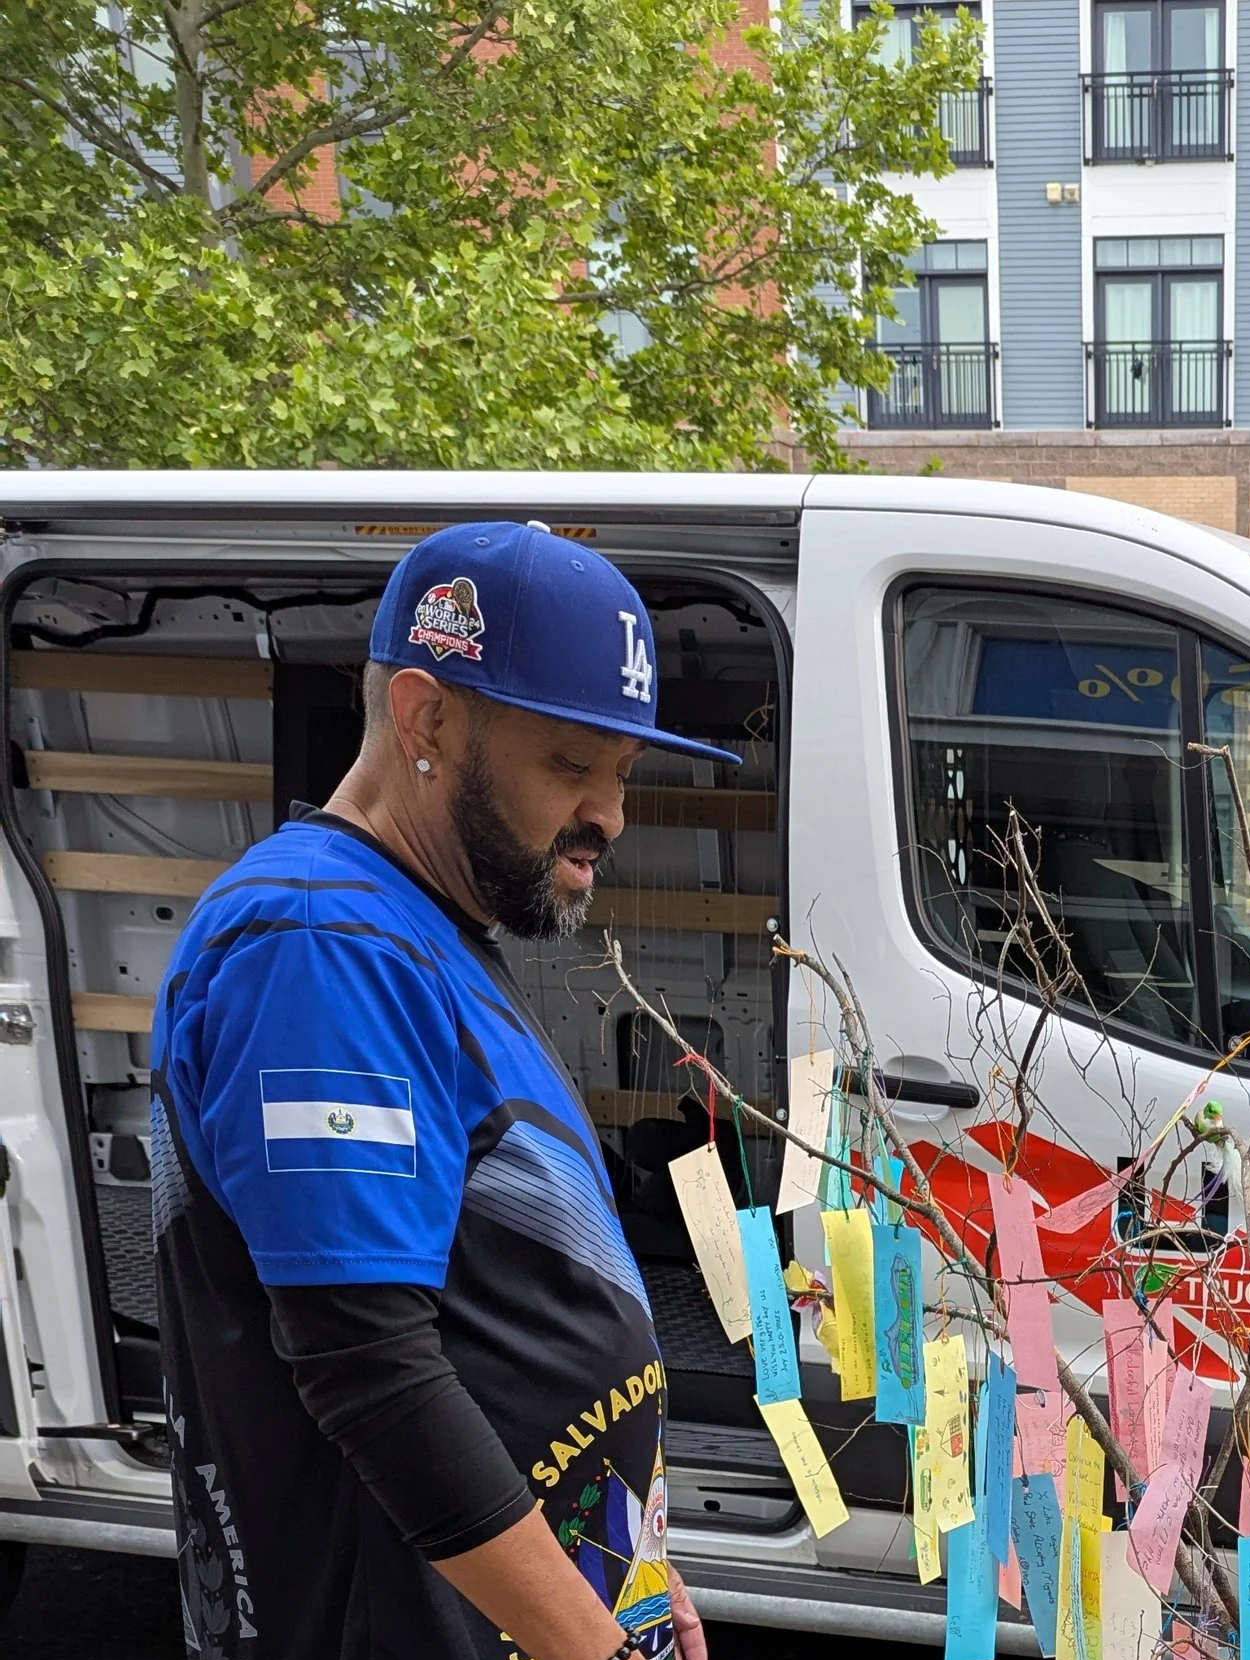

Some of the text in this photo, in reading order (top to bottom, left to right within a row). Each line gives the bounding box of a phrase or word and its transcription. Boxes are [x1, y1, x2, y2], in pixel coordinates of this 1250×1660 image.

[426, 603, 468, 625] WORLD
[423, 616, 468, 638] SERIES
[417, 629, 469, 651] CHAMPIONS
[618, 610, 652, 703] LA
[195, 1463, 258, 1639] AMERICA
